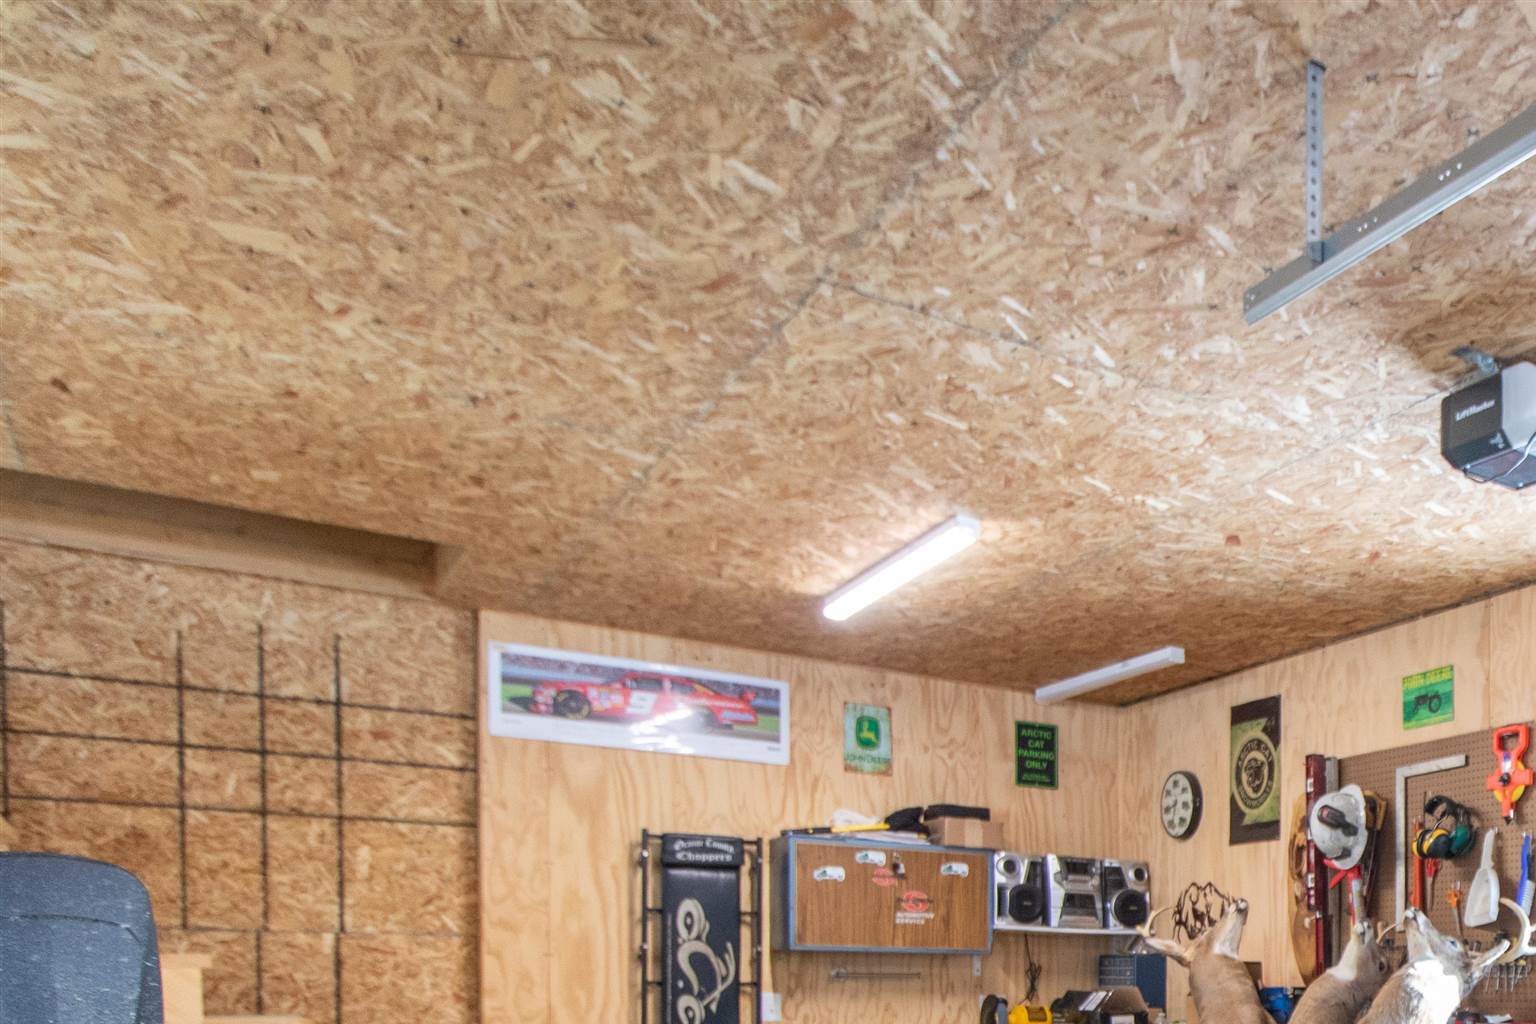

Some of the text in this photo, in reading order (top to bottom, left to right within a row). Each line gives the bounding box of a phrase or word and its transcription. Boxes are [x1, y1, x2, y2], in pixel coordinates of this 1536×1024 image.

[1455, 399, 1496, 421] LiftMaster
[1021, 729, 1052, 741] ARCTIC
[1027, 740, 1046, 750] CAT
[1018, 748, 1055, 761] PARKING
[1025, 760, 1048, 770] ONLY
[675, 850, 733, 862] Choppers
